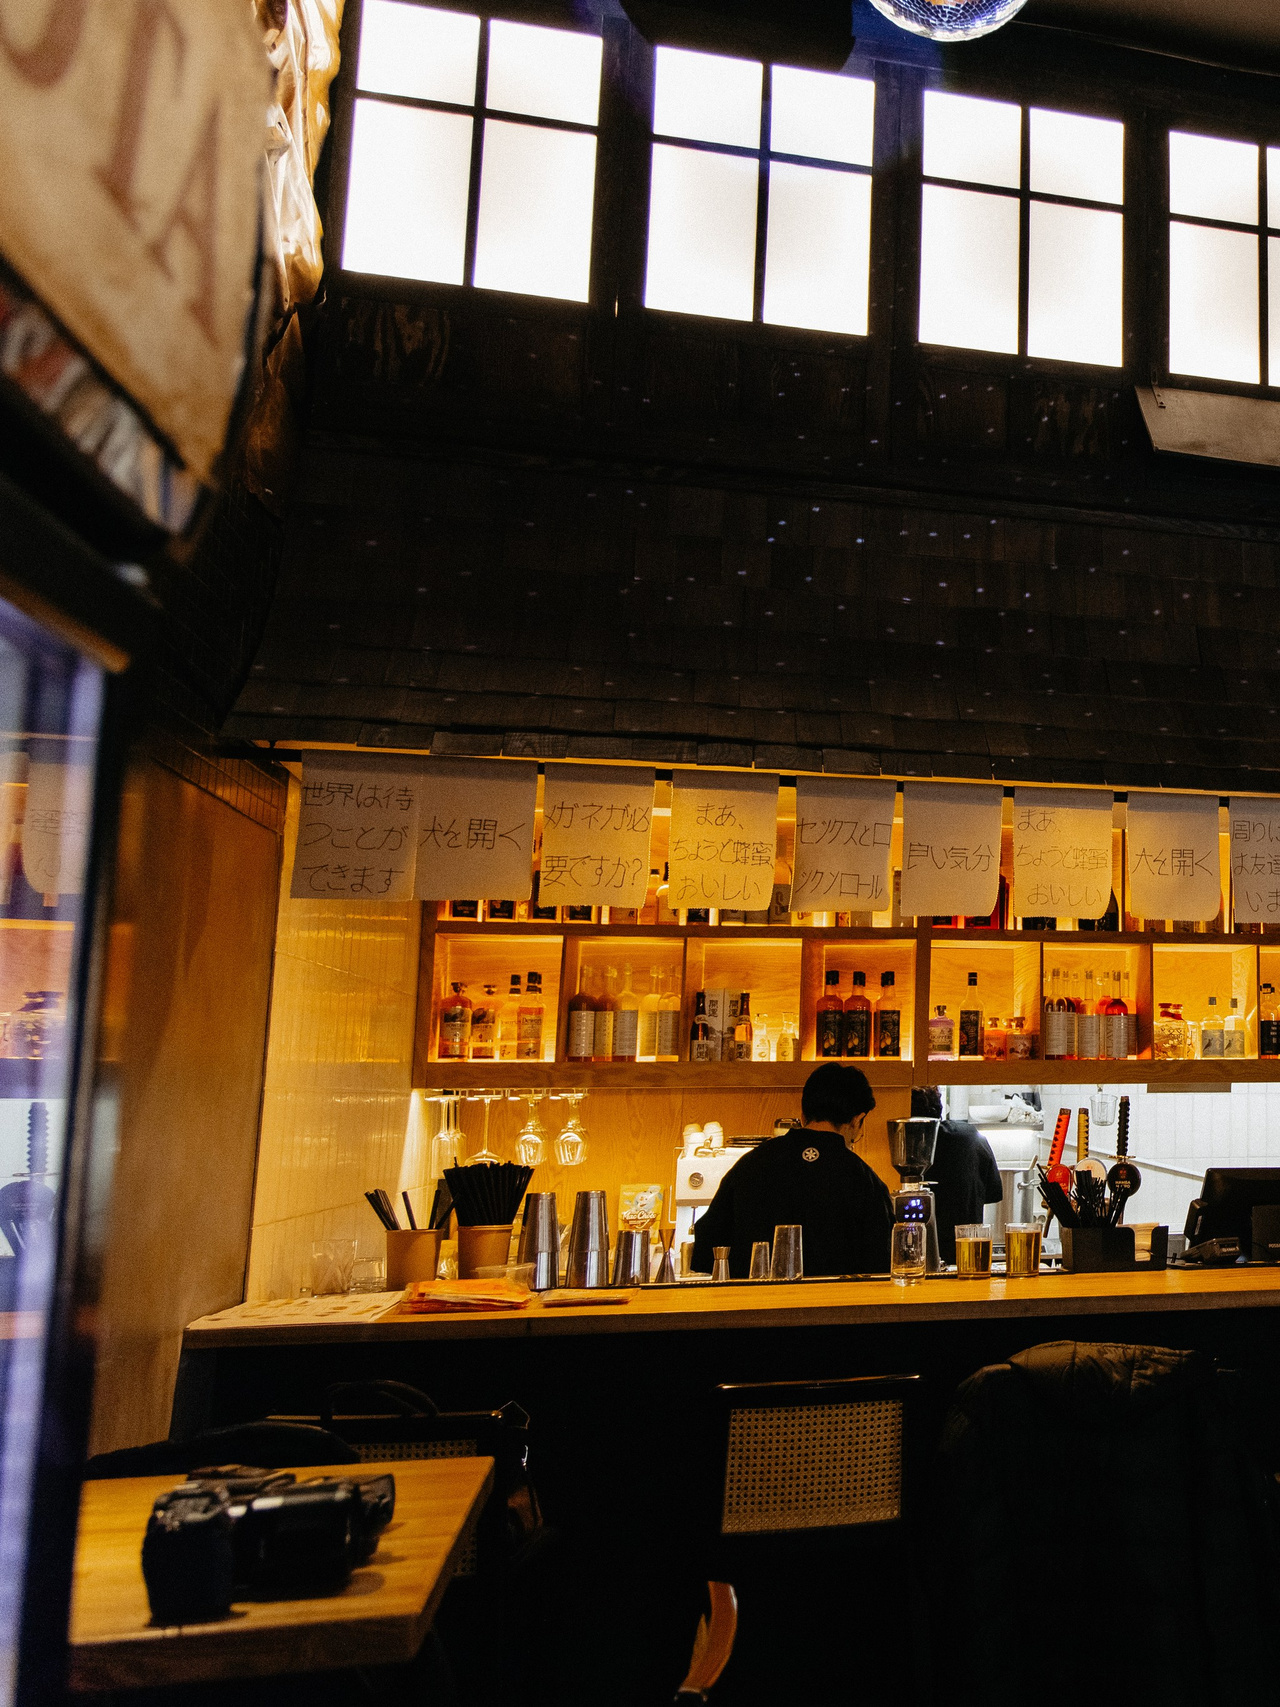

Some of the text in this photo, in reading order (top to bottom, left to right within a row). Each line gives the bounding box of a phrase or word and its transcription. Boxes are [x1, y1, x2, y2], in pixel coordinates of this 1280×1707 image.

[303, 782, 414, 811] 世界は待
[304, 822, 408, 851] つことが
[419, 815, 526, 851] 犬を開く
[907, 842, 994, 872] 良い気分
[302, 864, 404, 893] できます
[676, 873, 760, 900] おいしい
[1027, 883, 1101, 906] おいしい
